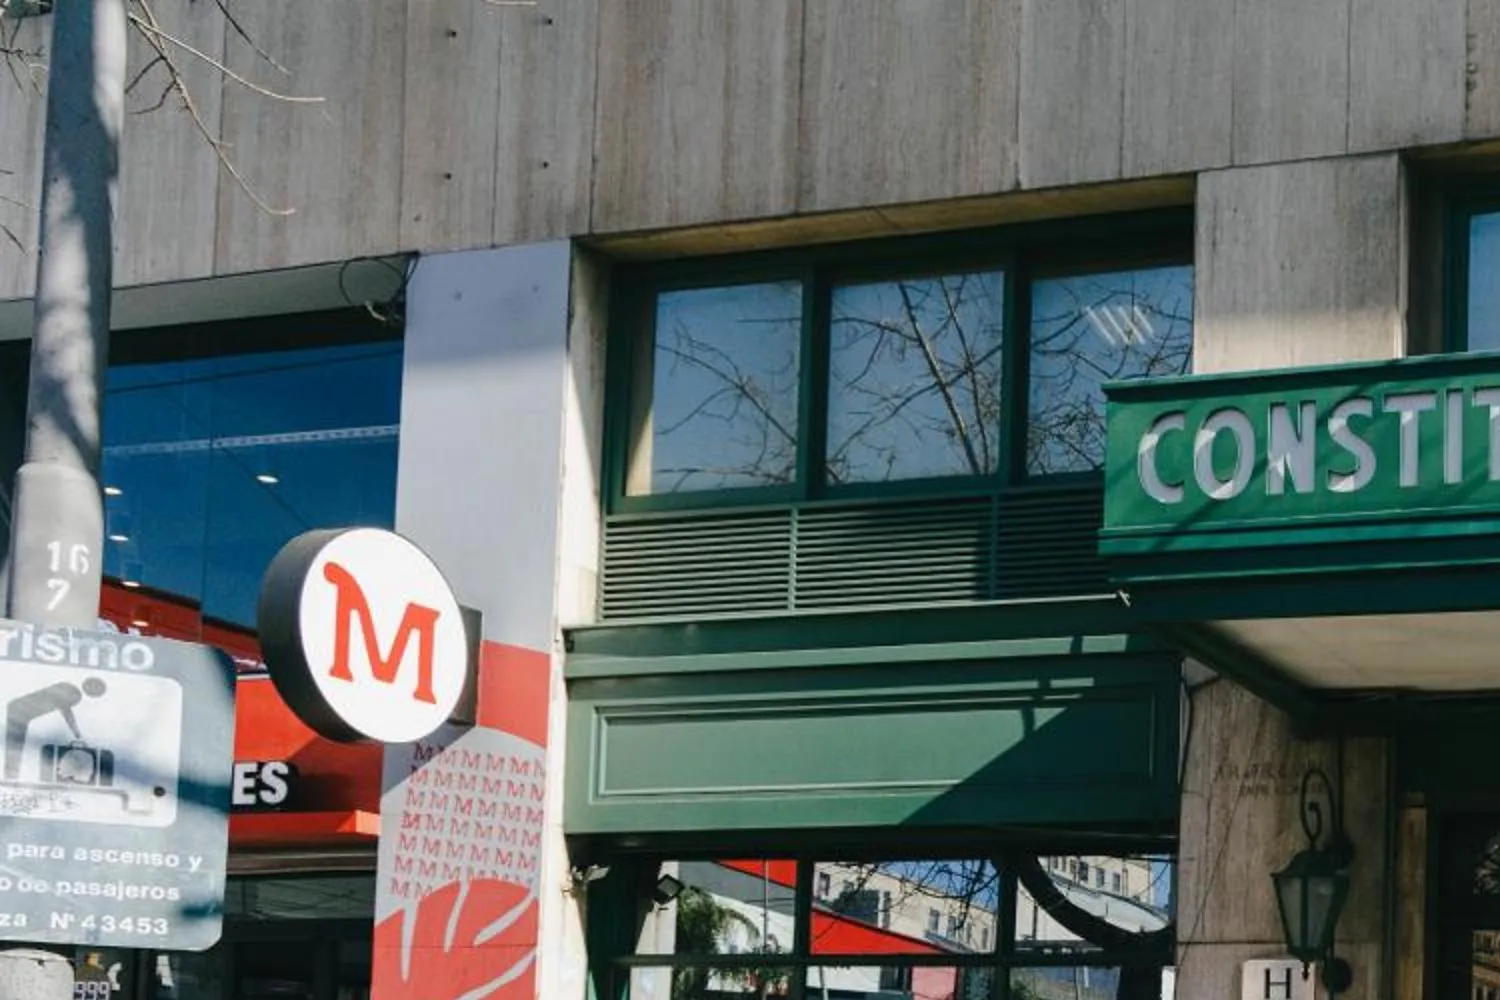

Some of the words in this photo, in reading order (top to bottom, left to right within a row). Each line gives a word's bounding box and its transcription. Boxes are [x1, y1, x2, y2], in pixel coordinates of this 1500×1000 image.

[48, 541, 89, 574] 16
[46, 578, 70, 611] 7
[324, 561, 440, 704] M
[232, 762, 289, 805] ES
[6, 842, 65, 861] para
[74, 847, 180, 868] ascenso
[189, 852, 203, 873] y
[56, 880, 181, 901] pasajeros
[81, 914, 169, 935] 43453
[1265, 967, 1292, 1000] H
